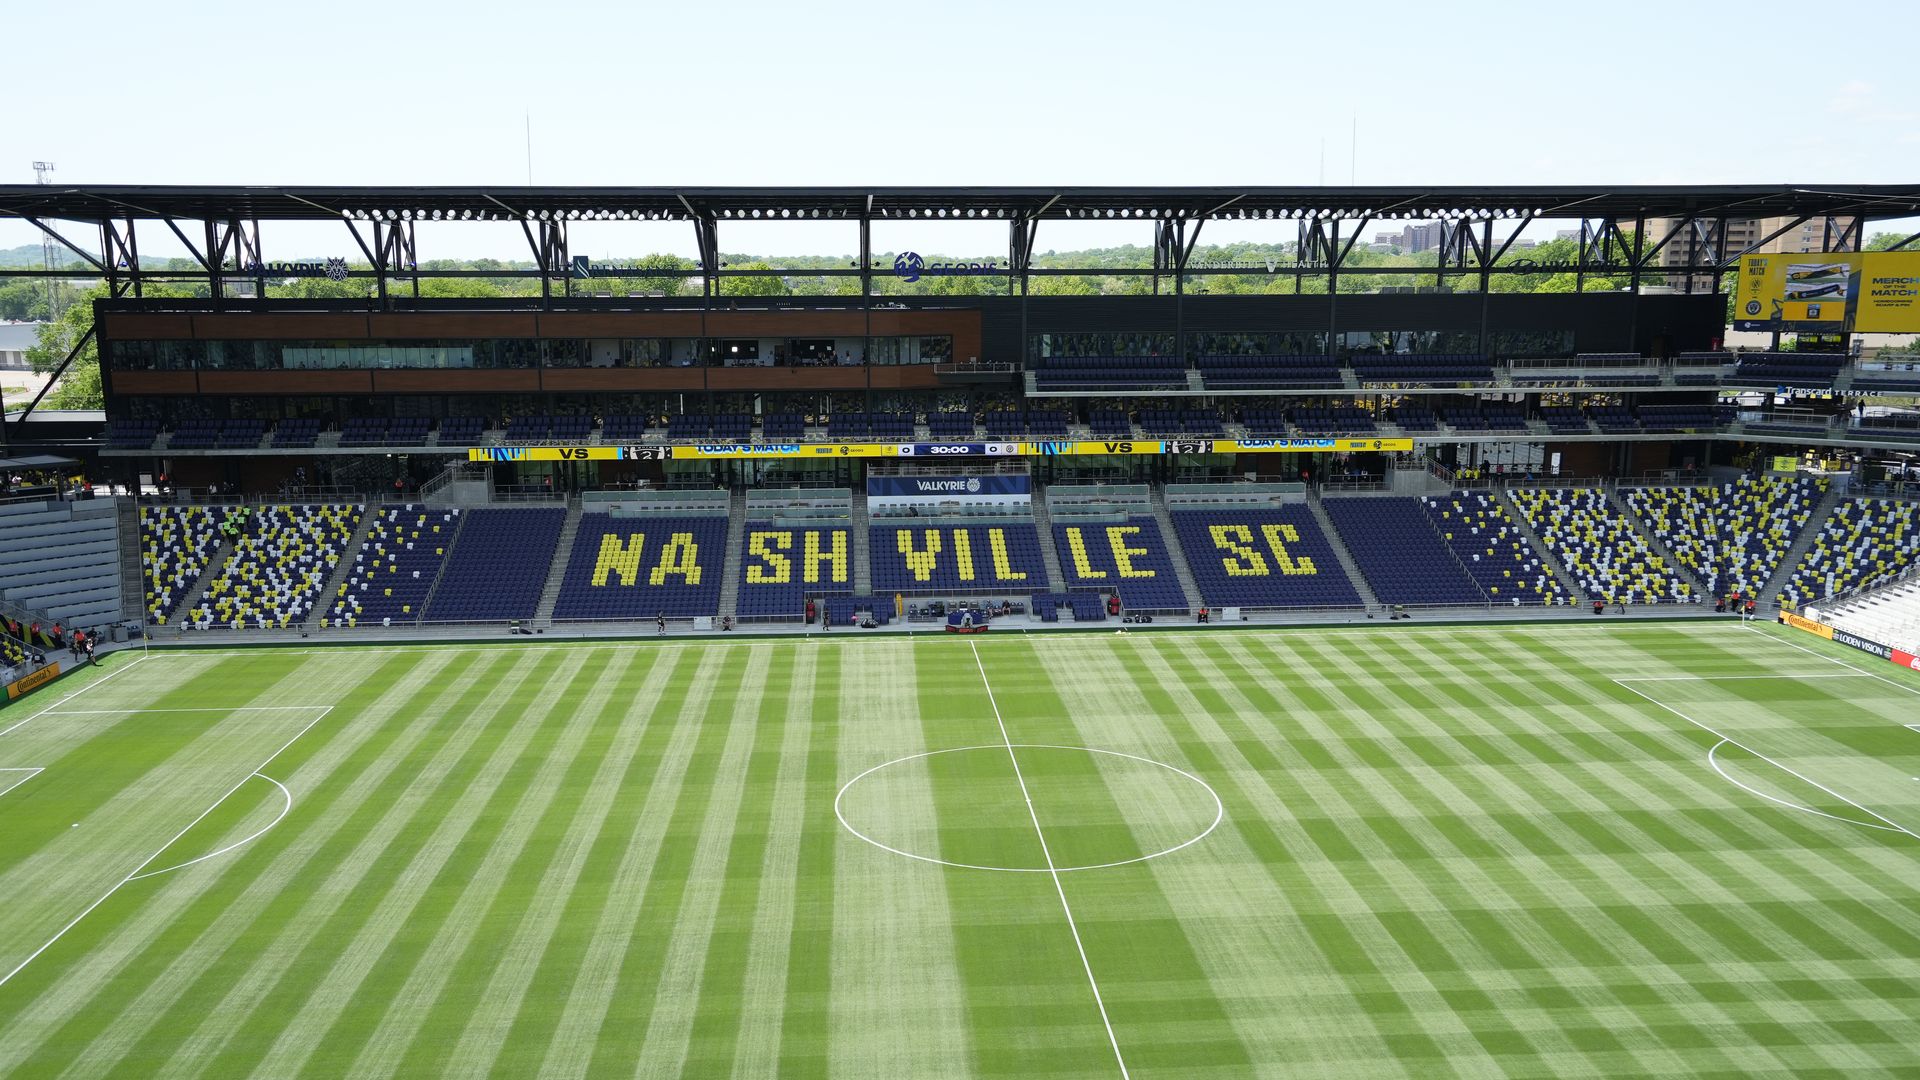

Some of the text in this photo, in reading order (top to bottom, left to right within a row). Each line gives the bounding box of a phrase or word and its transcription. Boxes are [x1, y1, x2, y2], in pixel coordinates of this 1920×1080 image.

[930, 263, 998, 275] GEODIS
[1871, 277, 1920, 285] MERCH
[1871, 289, 1918, 297] MATCH
[1785, 386, 1884, 398] Transcard TERRACE
[752, 444, 800, 454] MATCH
[1104, 442, 1133, 453] VS
[1290, 439, 1335, 448] MATCH
[558, 448, 589, 459] VS
[930, 446, 970, 454] 30:00
[917, 480, 966, 491] VALKYRIE
[1208, 523, 1318, 577] SC
[1789, 615, 1818, 632] Continental
[1839, 633, 1861, 648] LODEN
[1861, 641, 1884, 656] VISION
[17, 669, 48, 693] Continental
